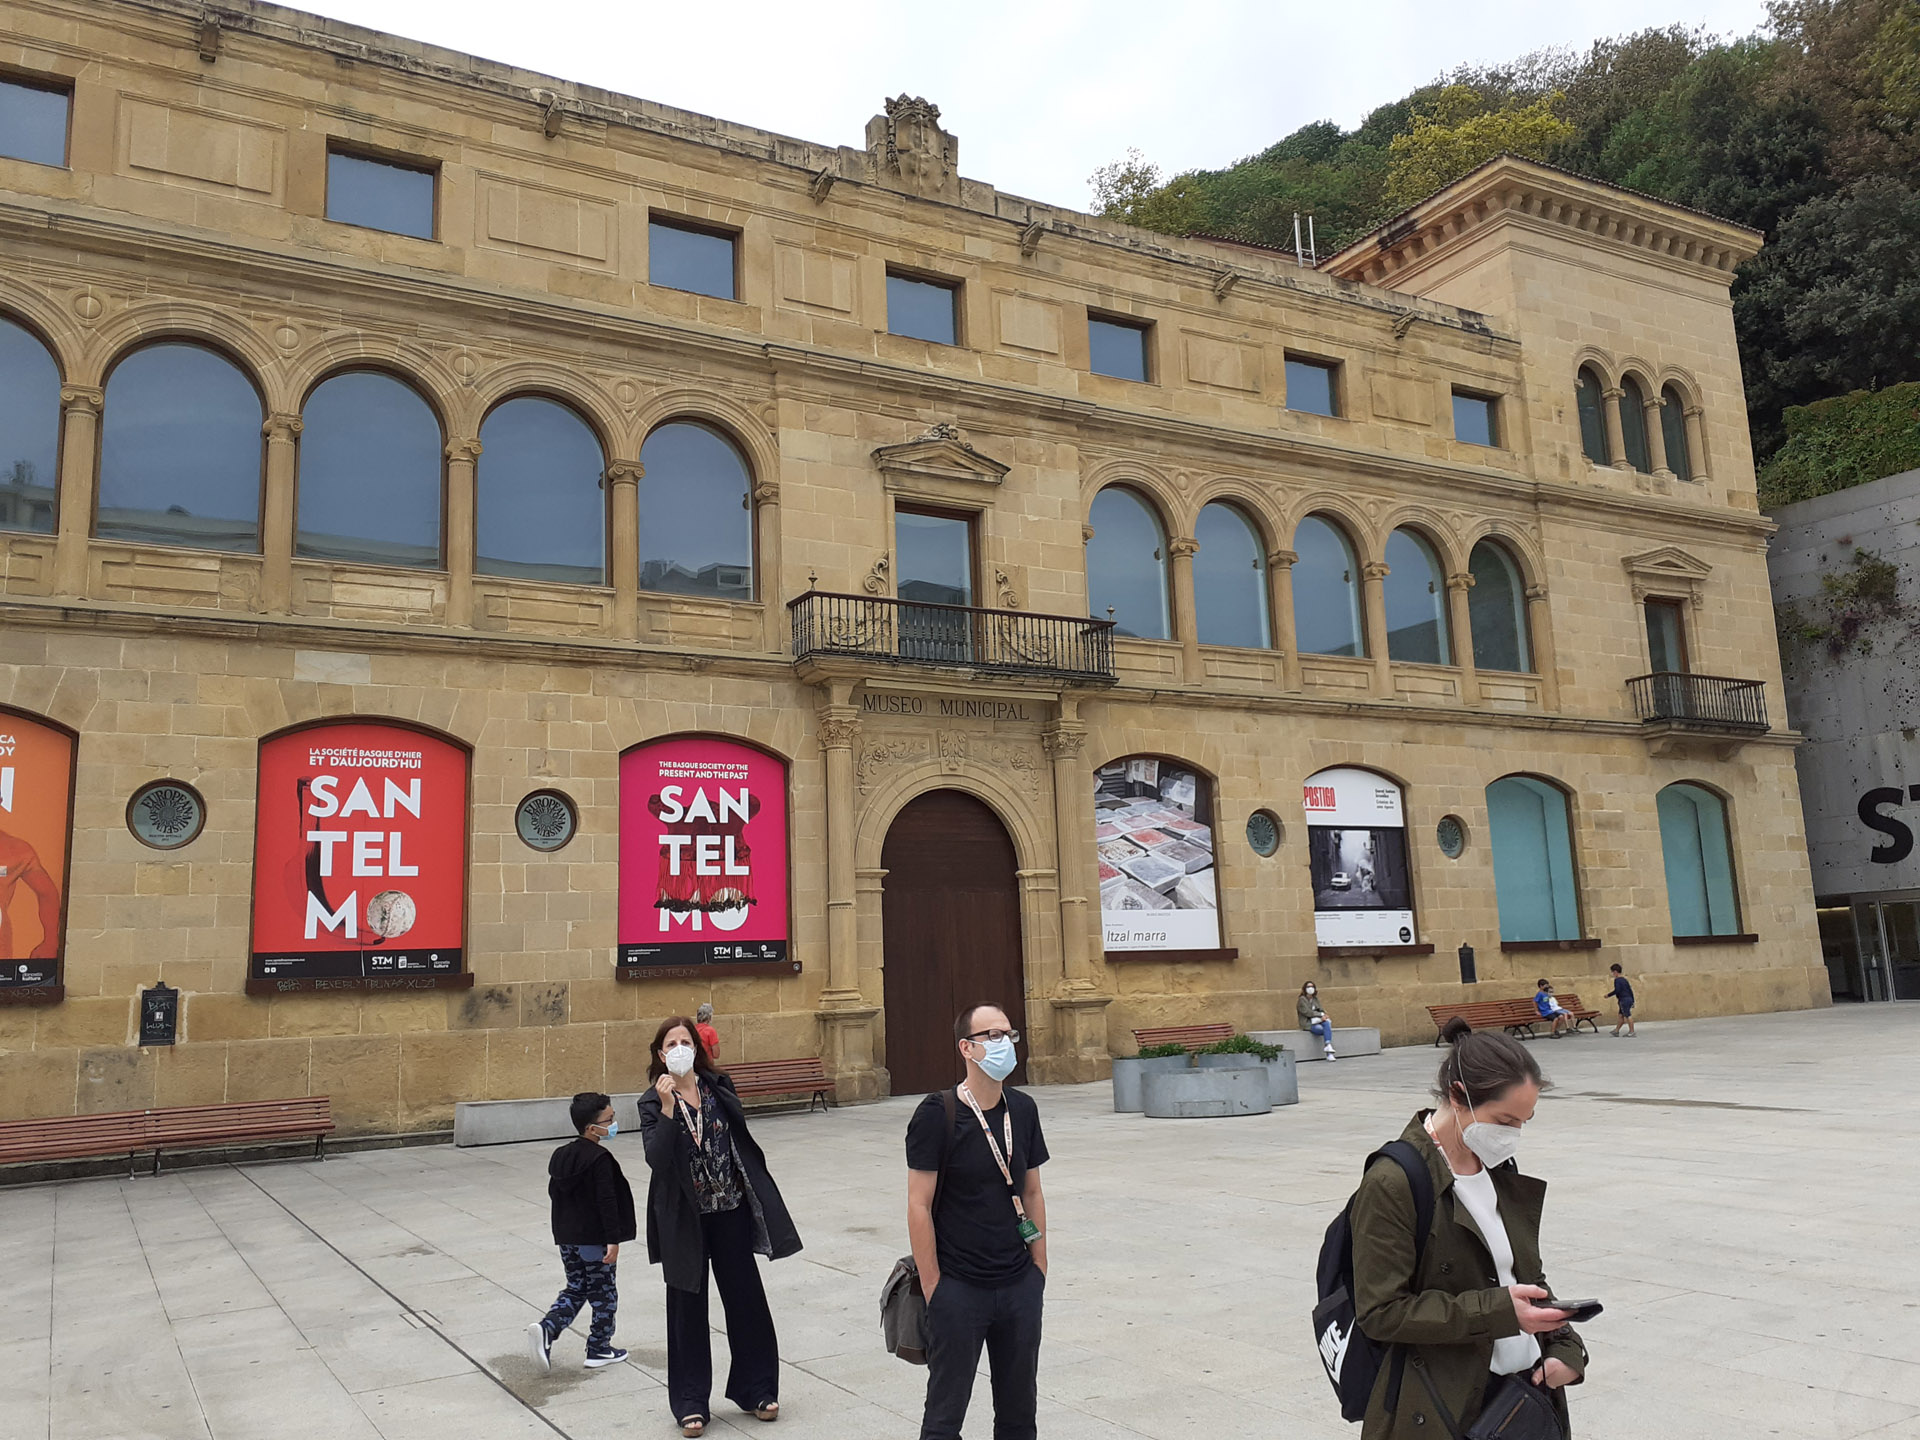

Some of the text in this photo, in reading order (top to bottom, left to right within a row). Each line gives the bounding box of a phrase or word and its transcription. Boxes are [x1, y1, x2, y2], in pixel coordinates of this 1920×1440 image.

[863, 694, 1030, 720] MUSEO MUNICIPAL
[309, 756, 422, 769] ET D'AUJOURD'HUI
[321, 747, 358, 757] SOCIÉTÉ
[359, 750, 394, 759] BASQUE
[394, 751, 422, 759] D'HIER
[699, 762, 726, 770] SOCIETY
[659, 769, 749, 780] PRESENT AND THE PAST
[308, 775, 421, 819] SAN
[658, 785, 750, 824] SAN
[1304, 786, 1336, 807] POSTIGO
[307, 831, 419, 877] TEL
[658, 834, 750, 876] TEL
[658, 887, 749, 932] MO
[1107, 930, 1167, 942] Itzal marra
[1319, 1320, 1346, 1369] NIKE
